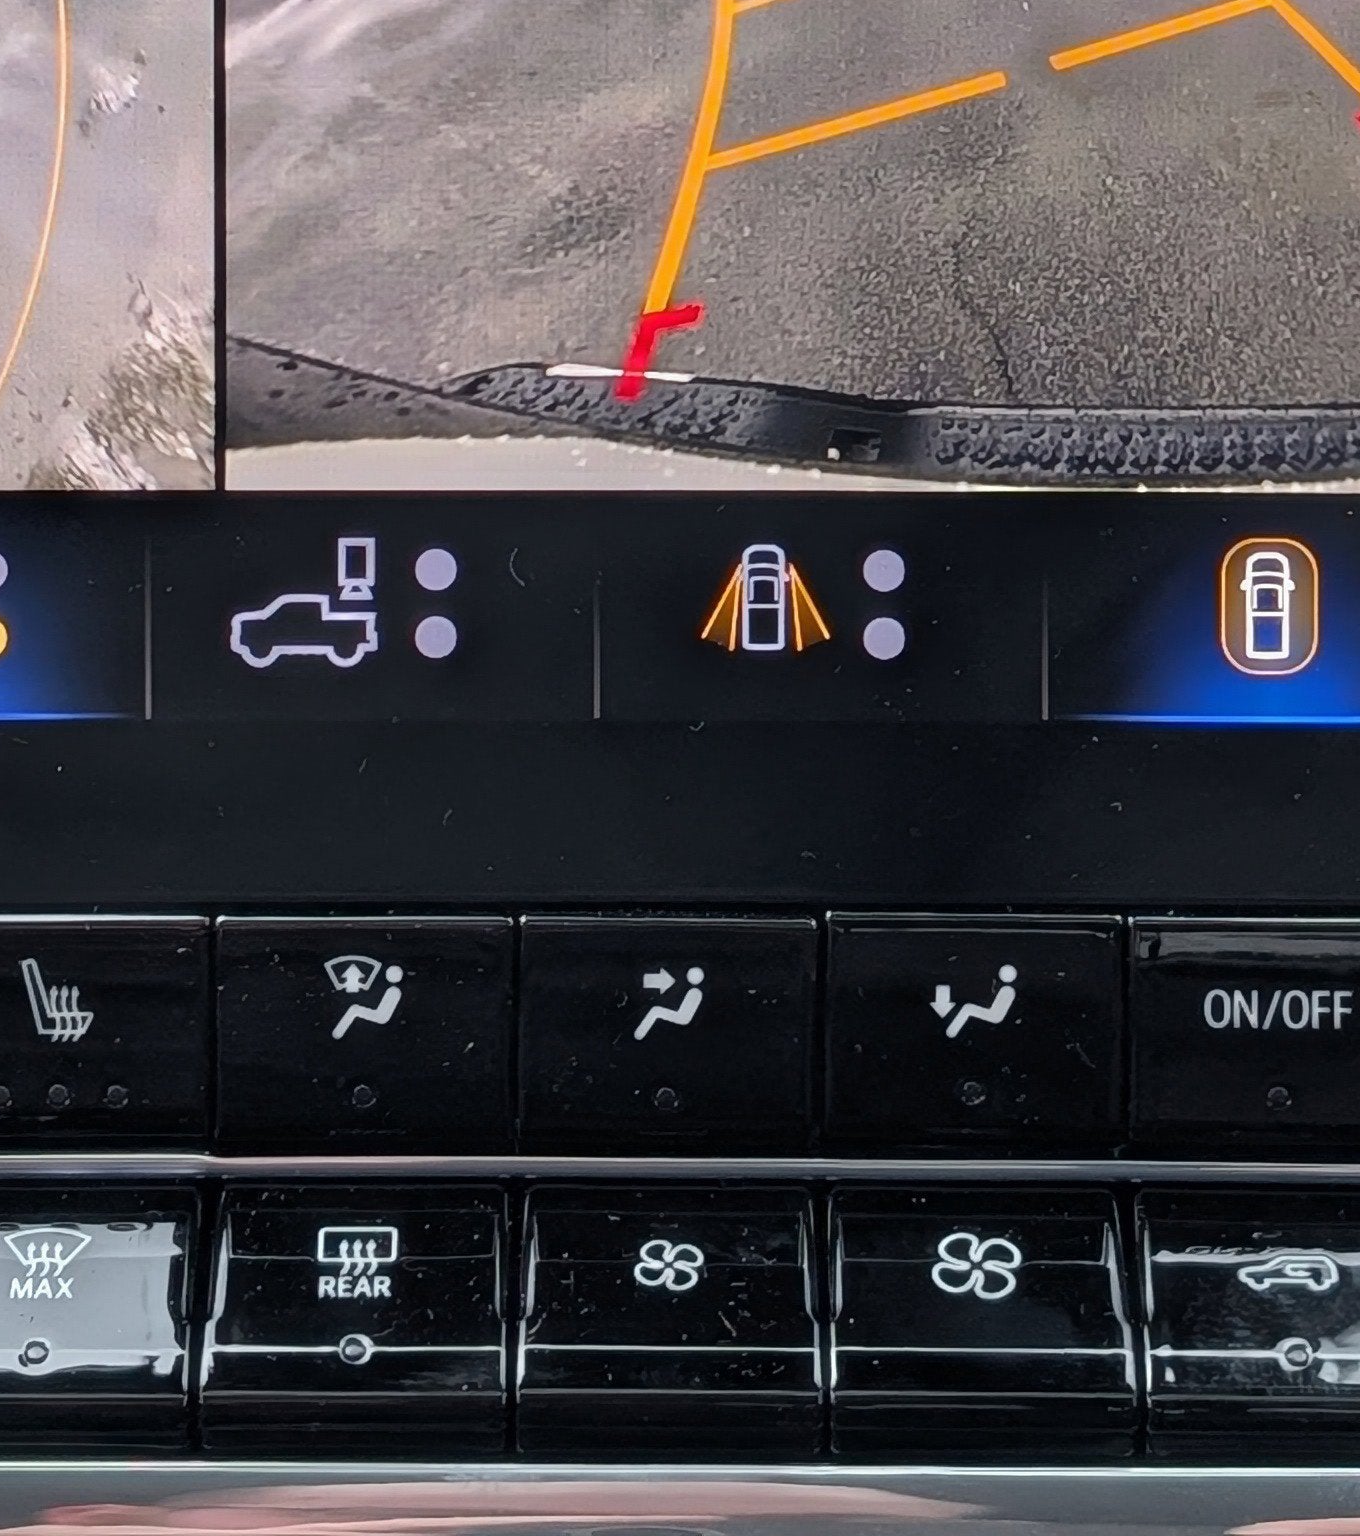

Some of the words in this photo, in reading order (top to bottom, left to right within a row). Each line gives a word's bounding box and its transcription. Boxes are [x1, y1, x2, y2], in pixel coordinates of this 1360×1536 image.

[1202, 988, 1354, 1031] ON/OFF
[8, 1276, 74, 1300] MAX
[317, 1275, 393, 1299] REAR
